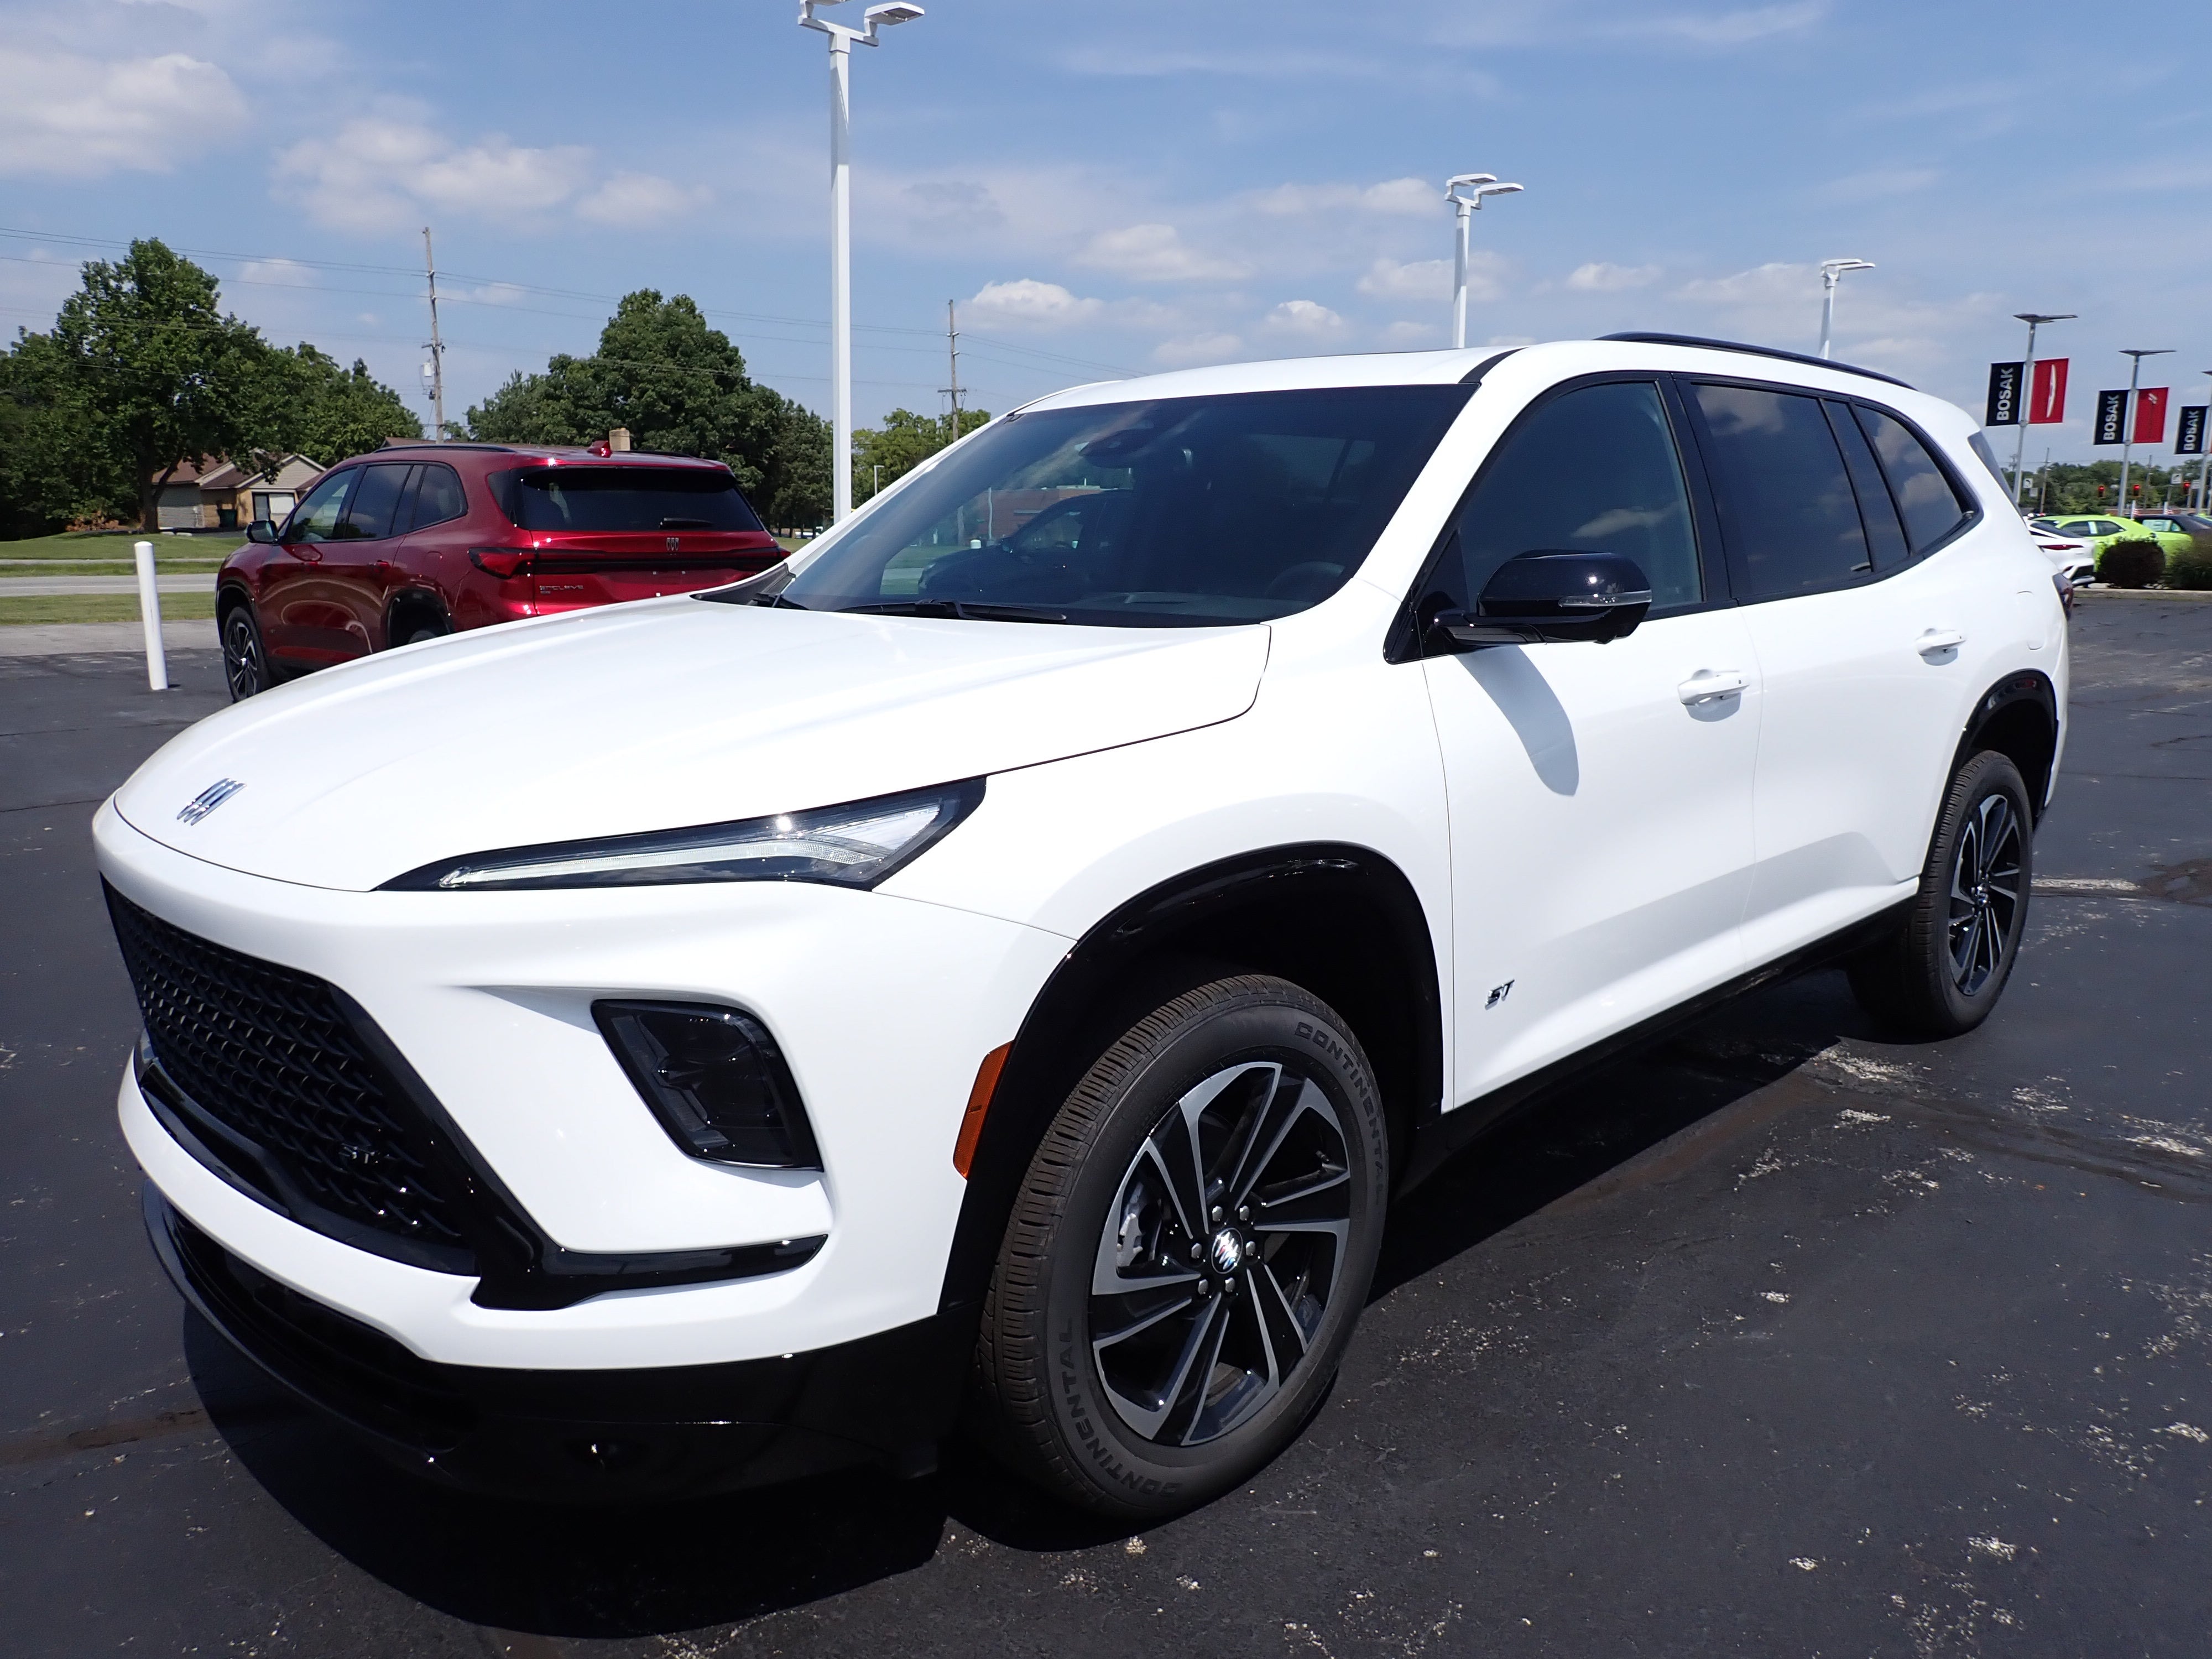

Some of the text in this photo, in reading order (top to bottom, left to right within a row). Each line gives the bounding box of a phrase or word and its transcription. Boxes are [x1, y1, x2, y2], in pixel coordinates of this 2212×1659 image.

[1996, 367, 2014, 421] BOSAK
[2103, 394, 2119, 440] BOSAK
[2183, 410, 2199, 451] BOSAK
[1485, 979, 1515, 1008] ST
[1295, 1022, 1383, 1206] CONTINENTAL
[1058, 1317, 1183, 1493] CONTINENTAL
